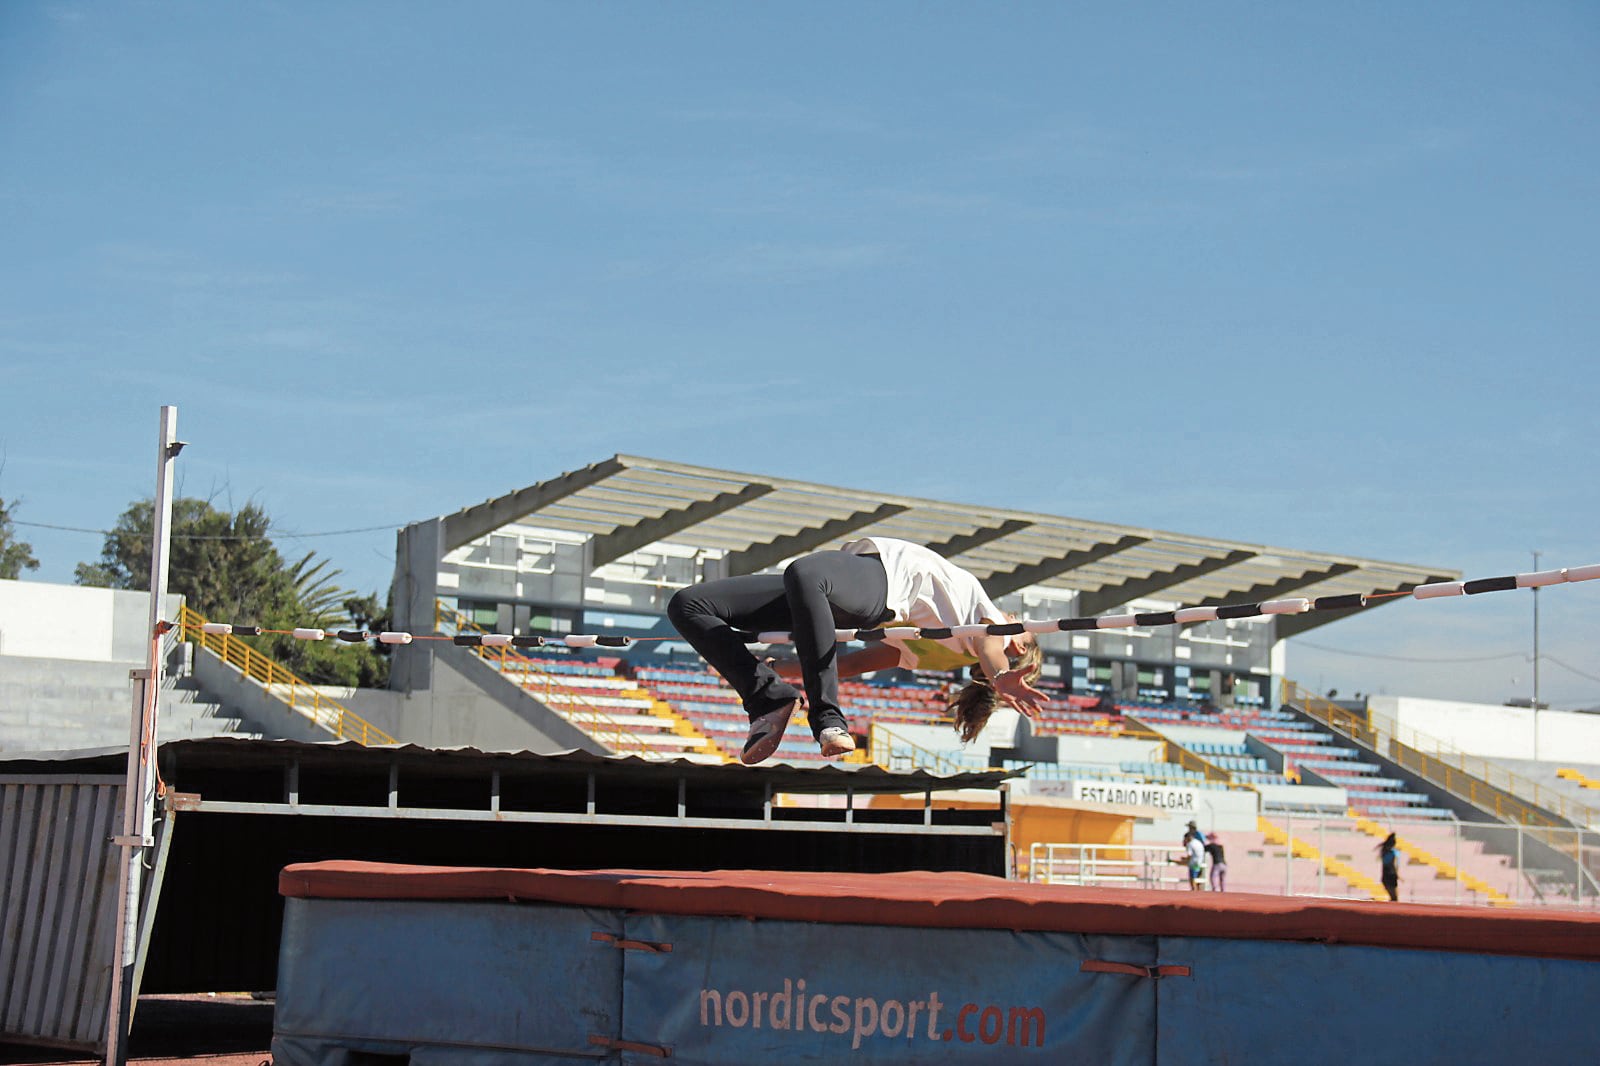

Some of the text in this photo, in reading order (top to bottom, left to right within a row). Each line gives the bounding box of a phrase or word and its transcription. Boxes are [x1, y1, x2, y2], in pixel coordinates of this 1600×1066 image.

[1081, 787, 1137, 806] ESTADIO
[1142, 791, 1193, 810] MELGAR
[700, 978, 1045, 1049] nordicsport.com
